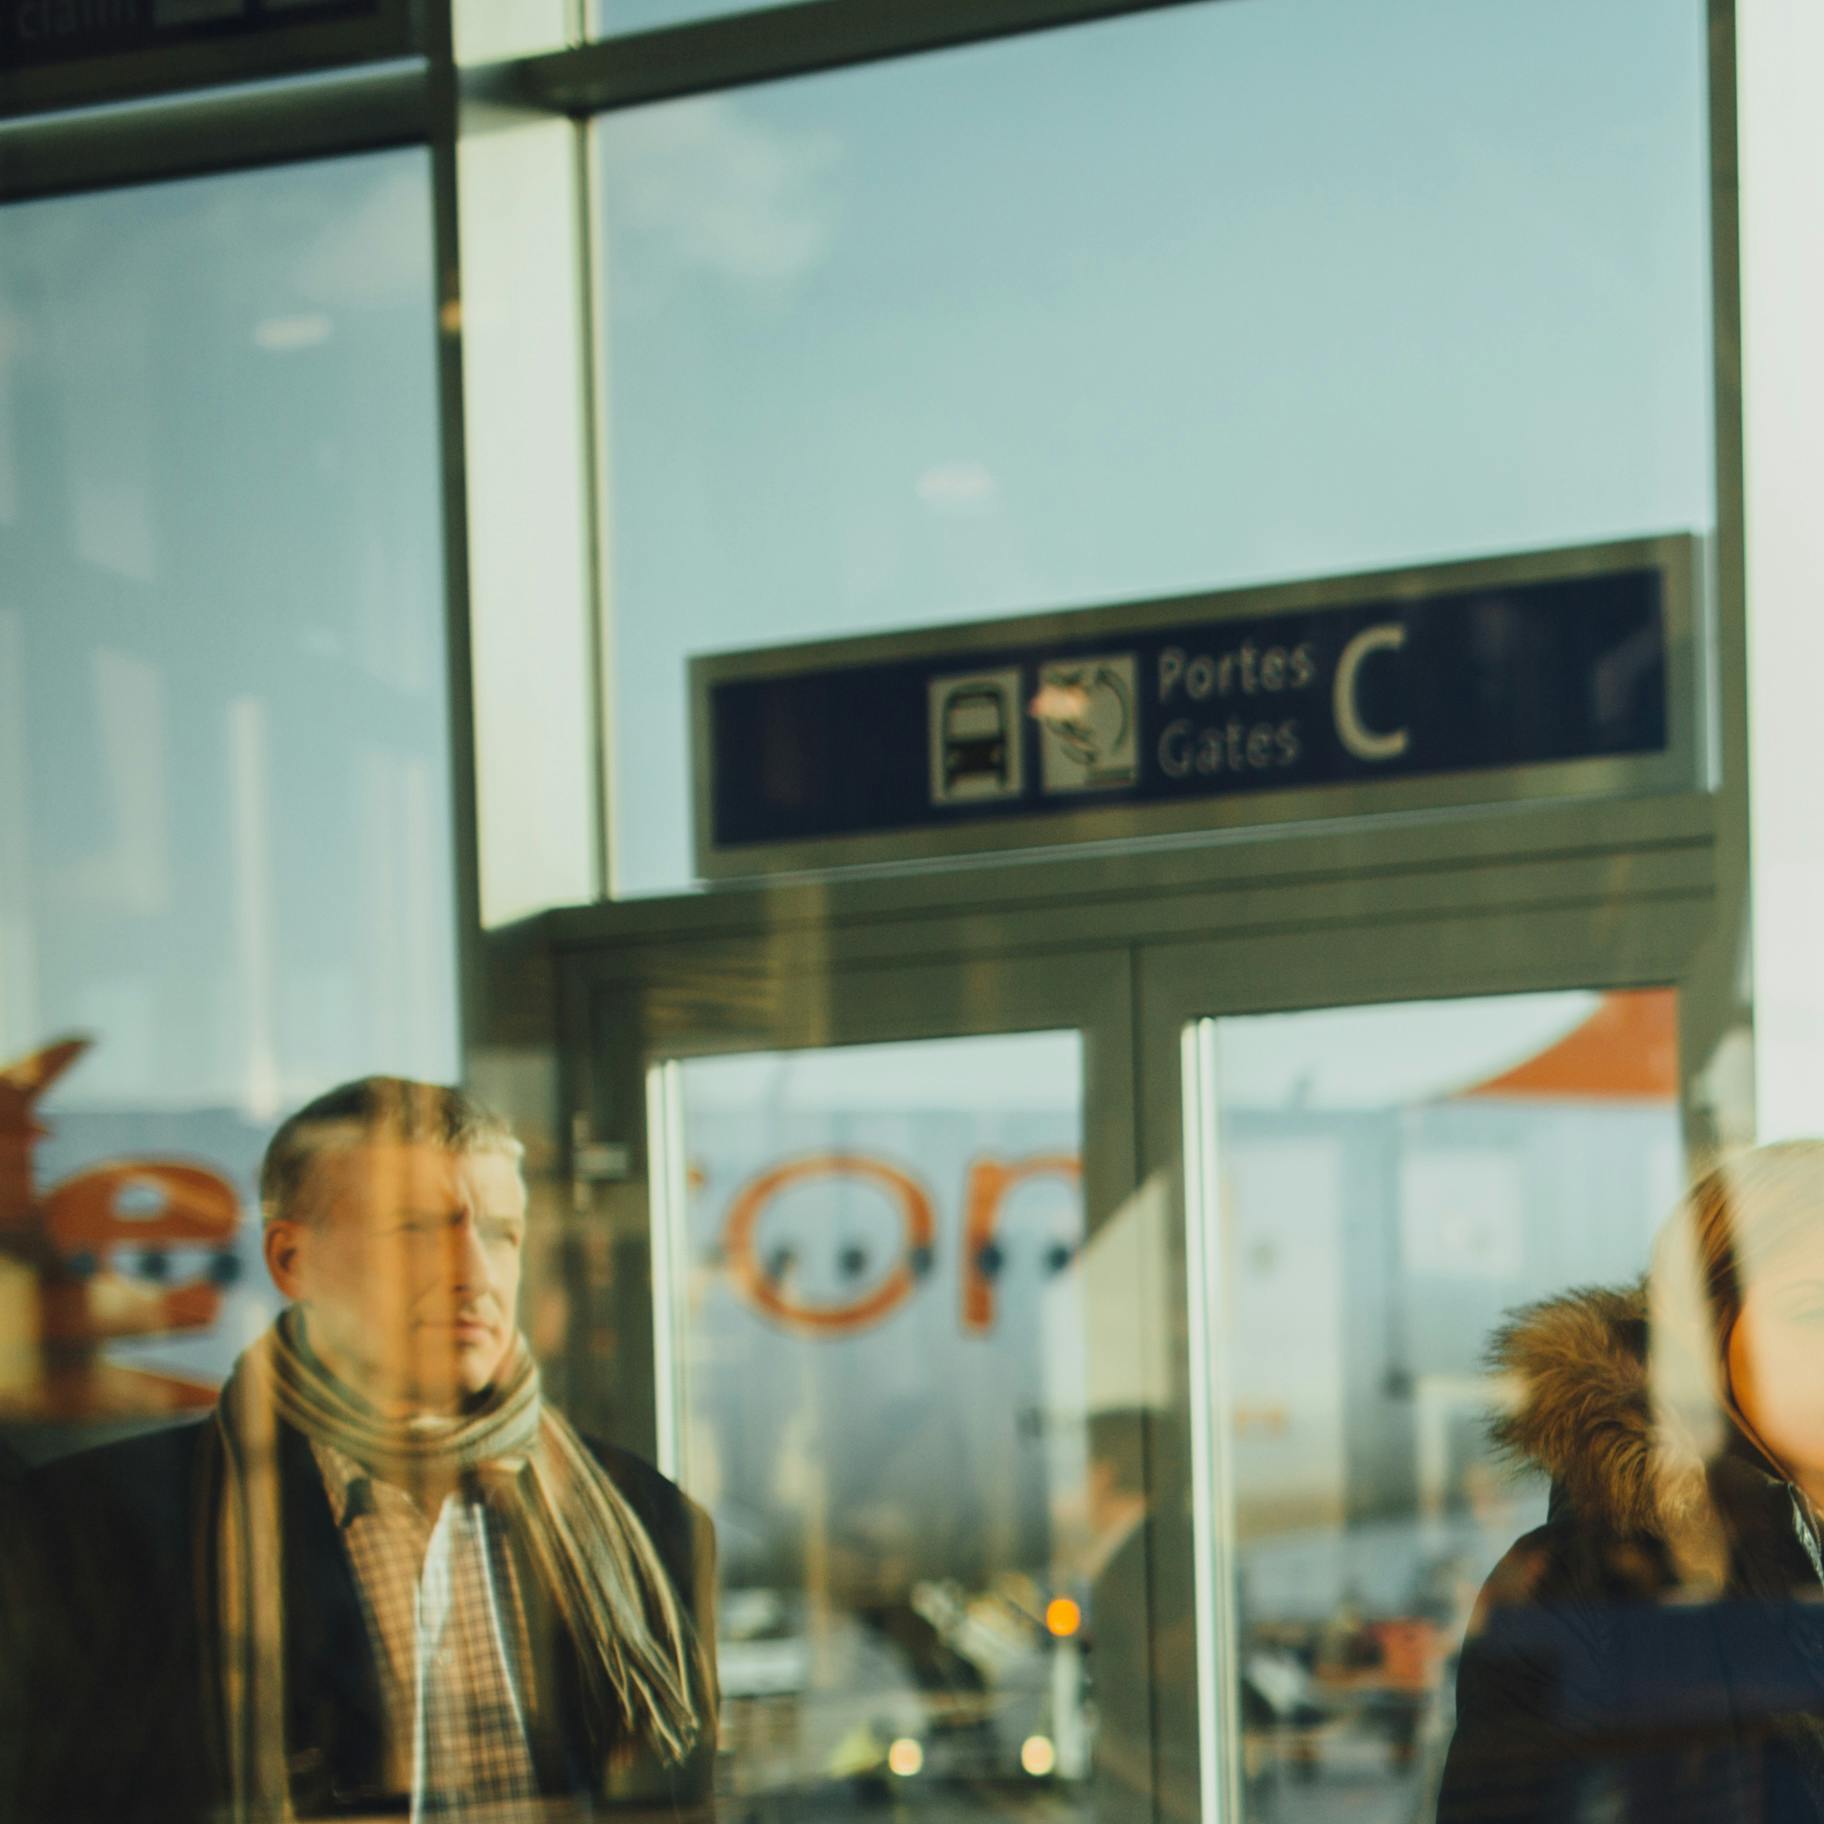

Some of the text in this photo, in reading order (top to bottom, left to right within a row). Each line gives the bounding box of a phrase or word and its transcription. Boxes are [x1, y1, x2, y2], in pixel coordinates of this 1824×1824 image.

[1158, 637, 1317, 700] Portes
[1333, 625, 1410, 760] C
[1158, 713, 1298, 777] Gates
